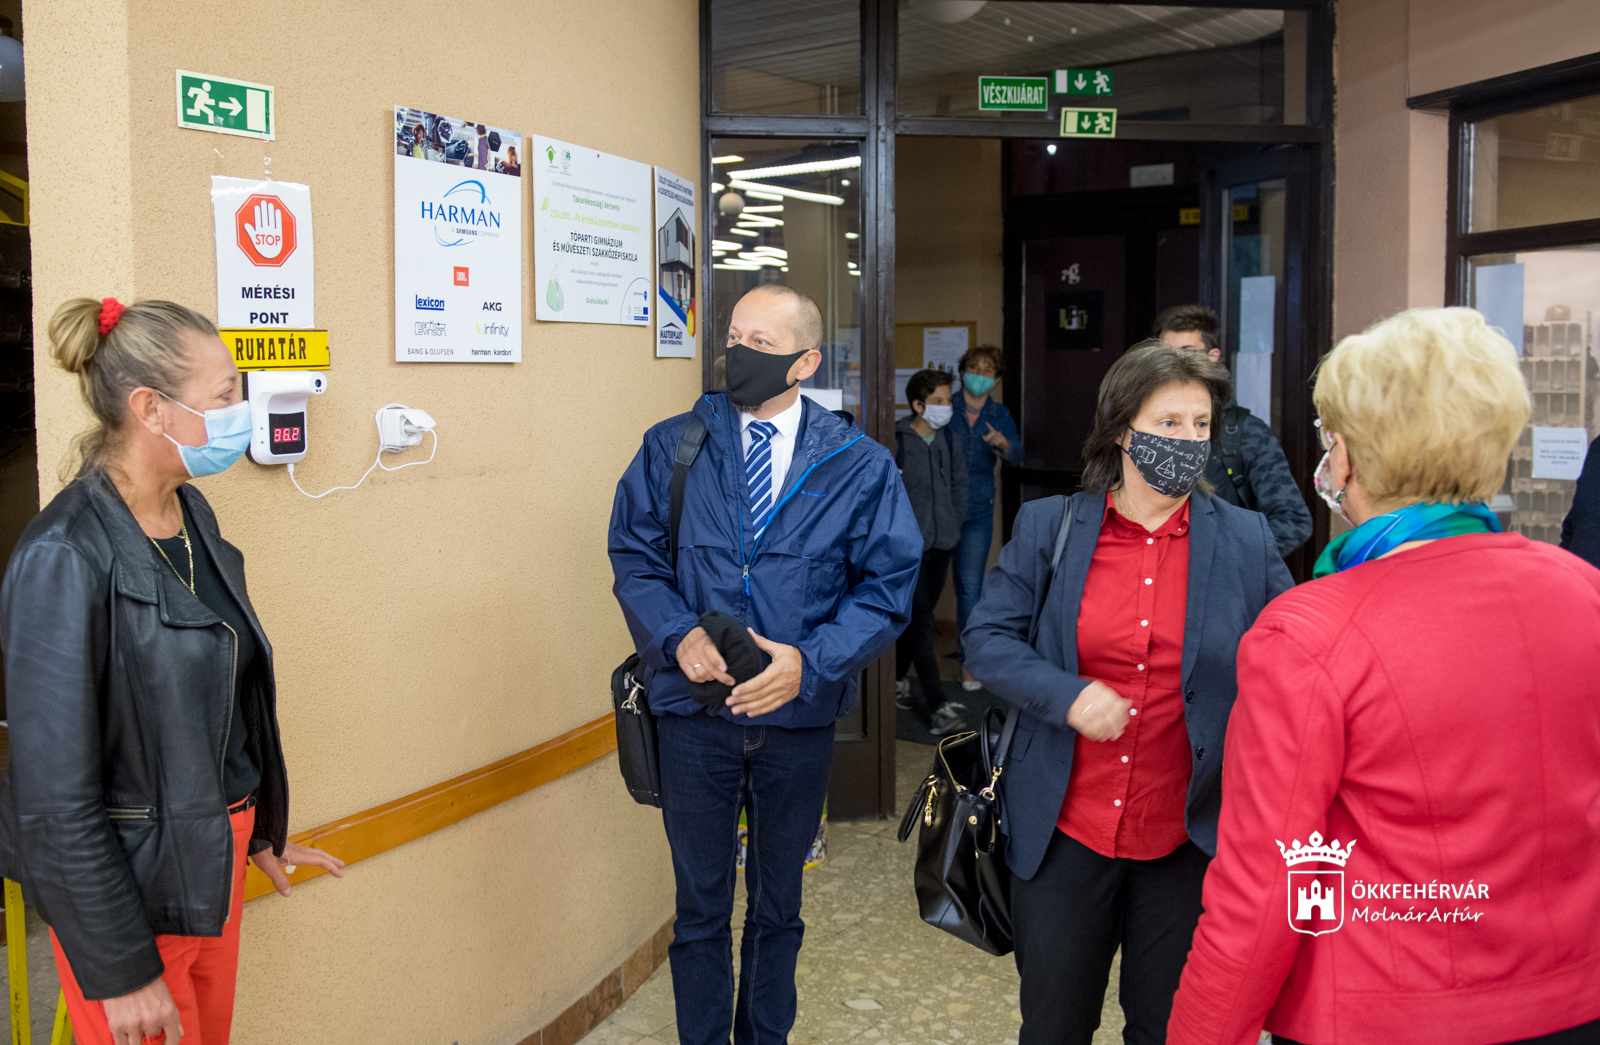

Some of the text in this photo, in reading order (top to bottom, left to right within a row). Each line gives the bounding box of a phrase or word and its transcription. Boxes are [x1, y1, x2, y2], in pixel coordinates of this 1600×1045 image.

[983, 82, 1044, 104] VÉSZKIJÁRAT
[572, 195, 603, 210] Takarékossági
[604, 201, 620, 213] Verseny
[421, 200, 500, 228] HARMAN
[575, 213, 580, 222] Ft
[598, 219, 620, 229] sportszer
[620, 224, 640, 234] utalvány
[255, 234, 281, 246] STOP
[456, 228, 478, 236] SAMSUNG
[570, 230, 623, 248] TÓPARTI GIMNÁZIUM
[553, 240, 638, 262] ÉS MŰVÉSZETI SZAKKÖZÉPISKOLA
[456, 271, 467, 281] JBL
[241, 284, 295, 299] MÉRÉSI
[415, 294, 444, 311] lexicon
[482, 302, 502, 311] AKG
[586, 297, 609, 305] Gratulálunk!
[250, 312, 289, 324] PONT
[236, 334, 307, 361] RUHATÁR
[274, 427, 300, 442] 36.2
